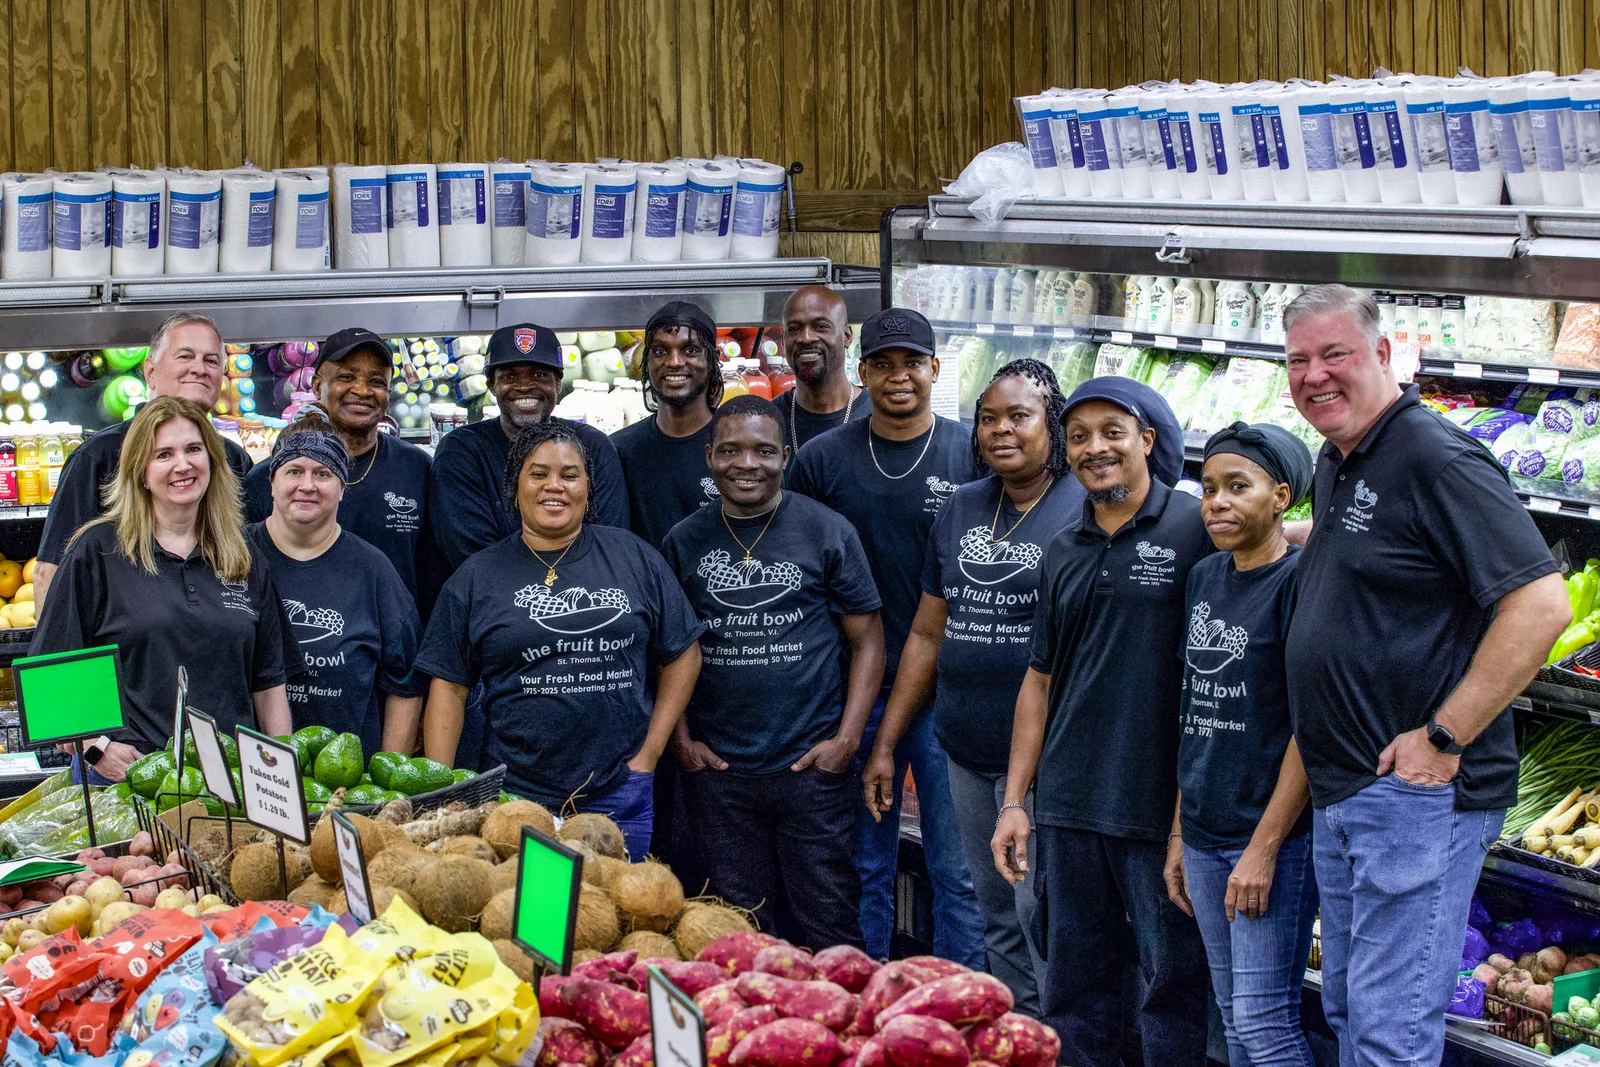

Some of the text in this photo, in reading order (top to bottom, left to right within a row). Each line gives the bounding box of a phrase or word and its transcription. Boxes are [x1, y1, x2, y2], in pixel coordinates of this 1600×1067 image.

[597, 198, 614, 206] TORK
[962, 585, 992, 604] fruit
[995, 588, 1039, 605] bowl
[726, 612, 758, 626] fruit
[763, 607, 804, 626] bowl
[968, 606, 995, 615] Thomas,
[767, 628, 779, 636] V.I.
[968, 622, 992, 632] Food
[996, 624, 1032, 633] Marke
[953, 632, 992, 644] Celebrating
[522, 633, 635, 663] the fruit bowl
[716, 646, 738, 656] Fresh
[742, 645, 766, 655] Food
[769, 642, 803, 653] Market
[304, 651, 346, 667] bowl
[557, 654, 615, 666] St. Thomas, V.I.
[726, 656, 769, 666] Celebrating
[771, 654, 781, 663] 50
[782, 654, 802, 662] Years
[520, 668, 633, 684] Your Fresh Food Market
[286, 684, 343, 697] ood Market
[522, 680, 633, 695] 1975-2025 Celebrating 50 Years
[287, 692, 308, 703] 1975
[249, 765, 290, 789] Yukon Gold
[255, 783, 288, 804] Potatoes
[258, 799, 263, 809] $
[279, 808, 290, 820] lb.
